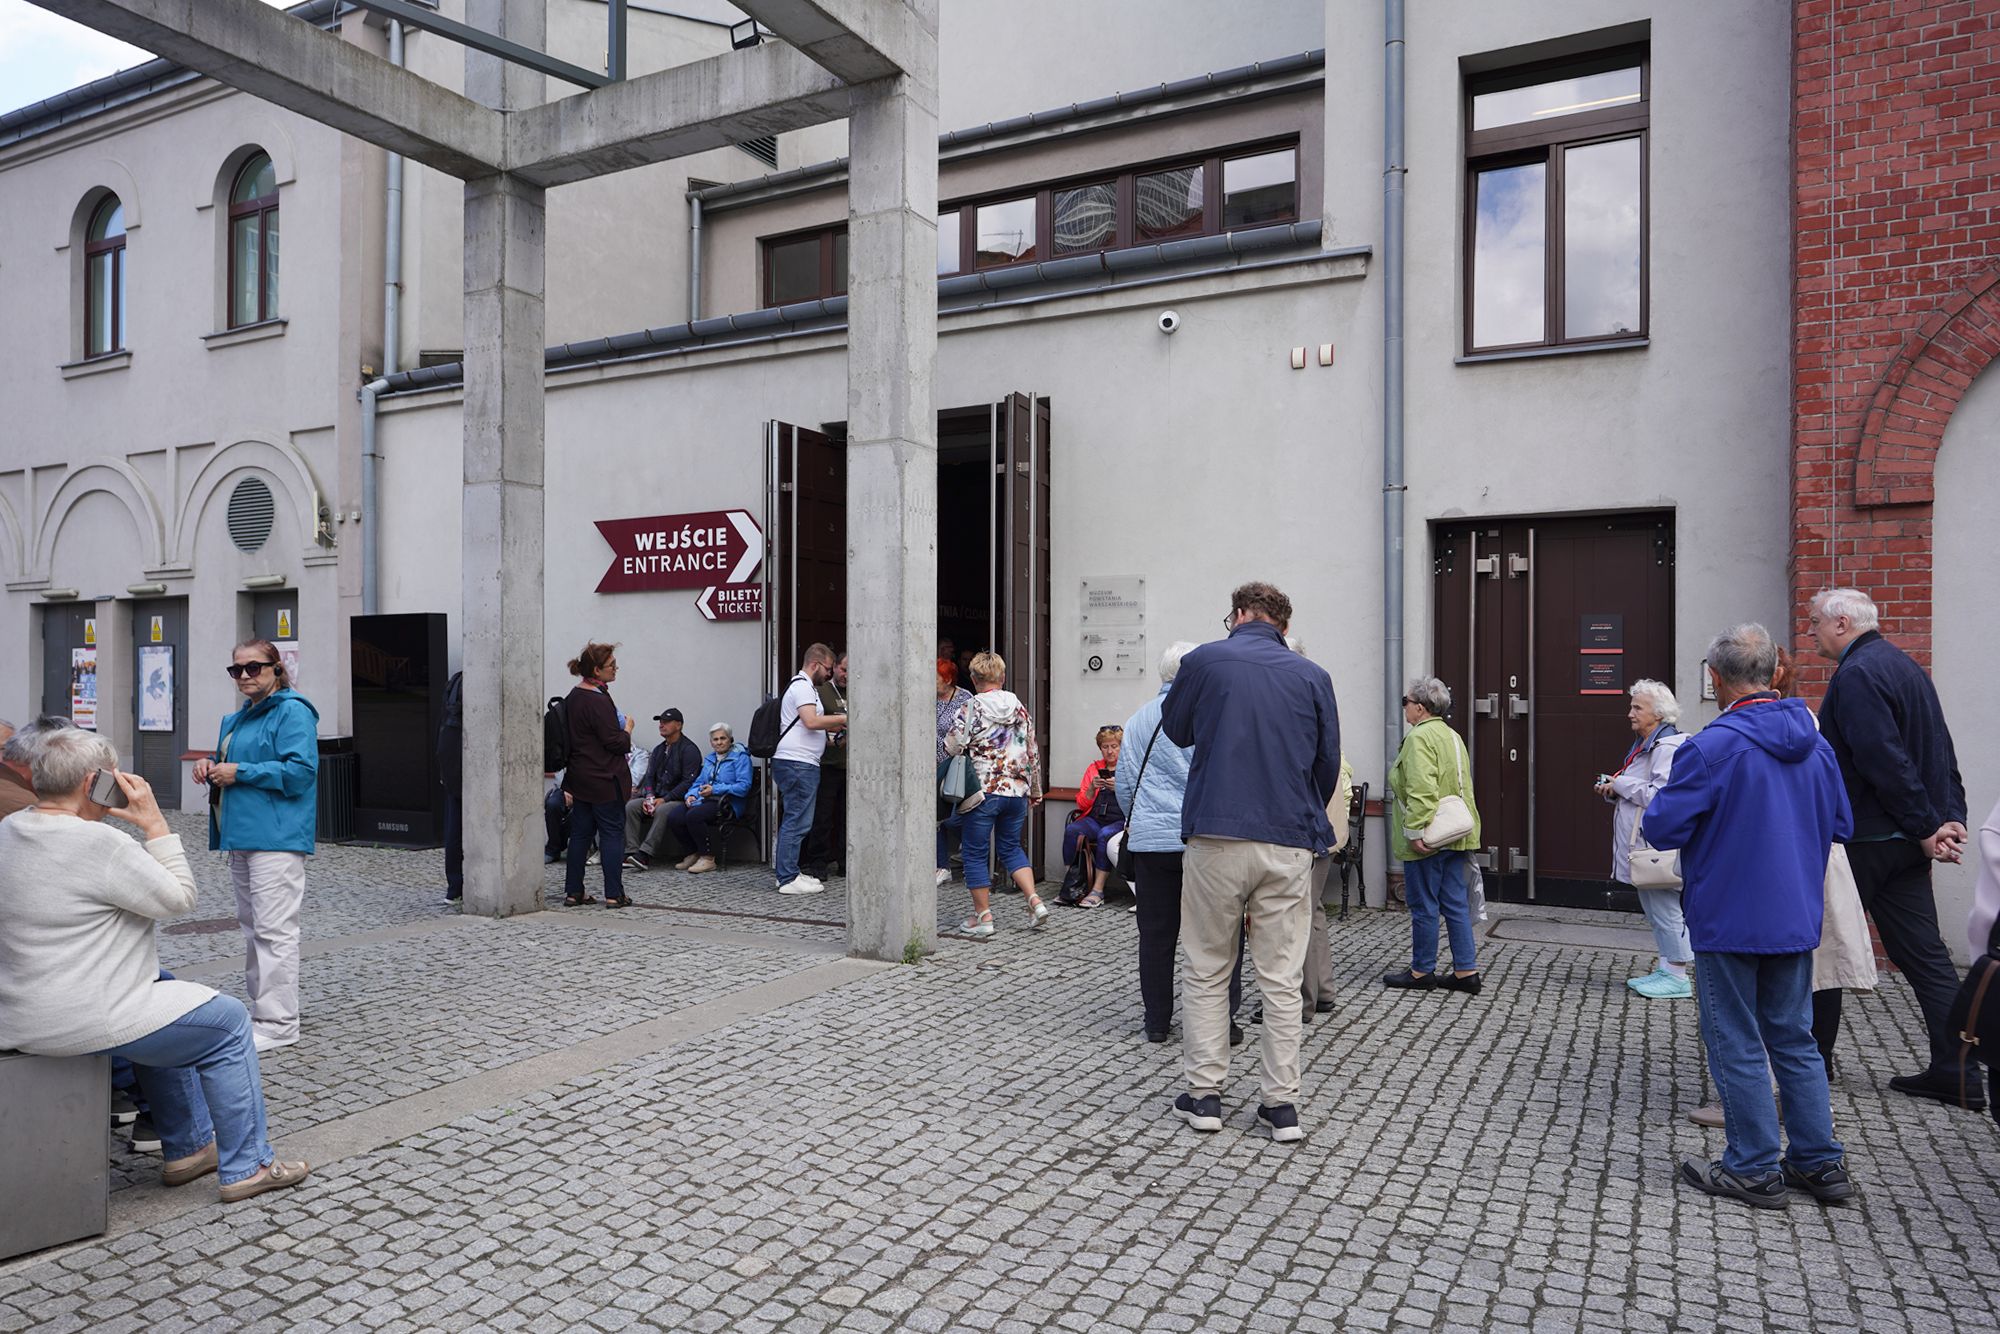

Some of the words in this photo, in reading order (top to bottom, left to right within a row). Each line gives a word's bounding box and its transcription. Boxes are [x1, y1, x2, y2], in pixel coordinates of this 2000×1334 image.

[634, 524, 727, 551] WEJŚCIE
[623, 551, 727, 574] ENTRANCE
[718, 589, 761, 601] BILETY
[377, 822, 408, 833] SAMSUNG
